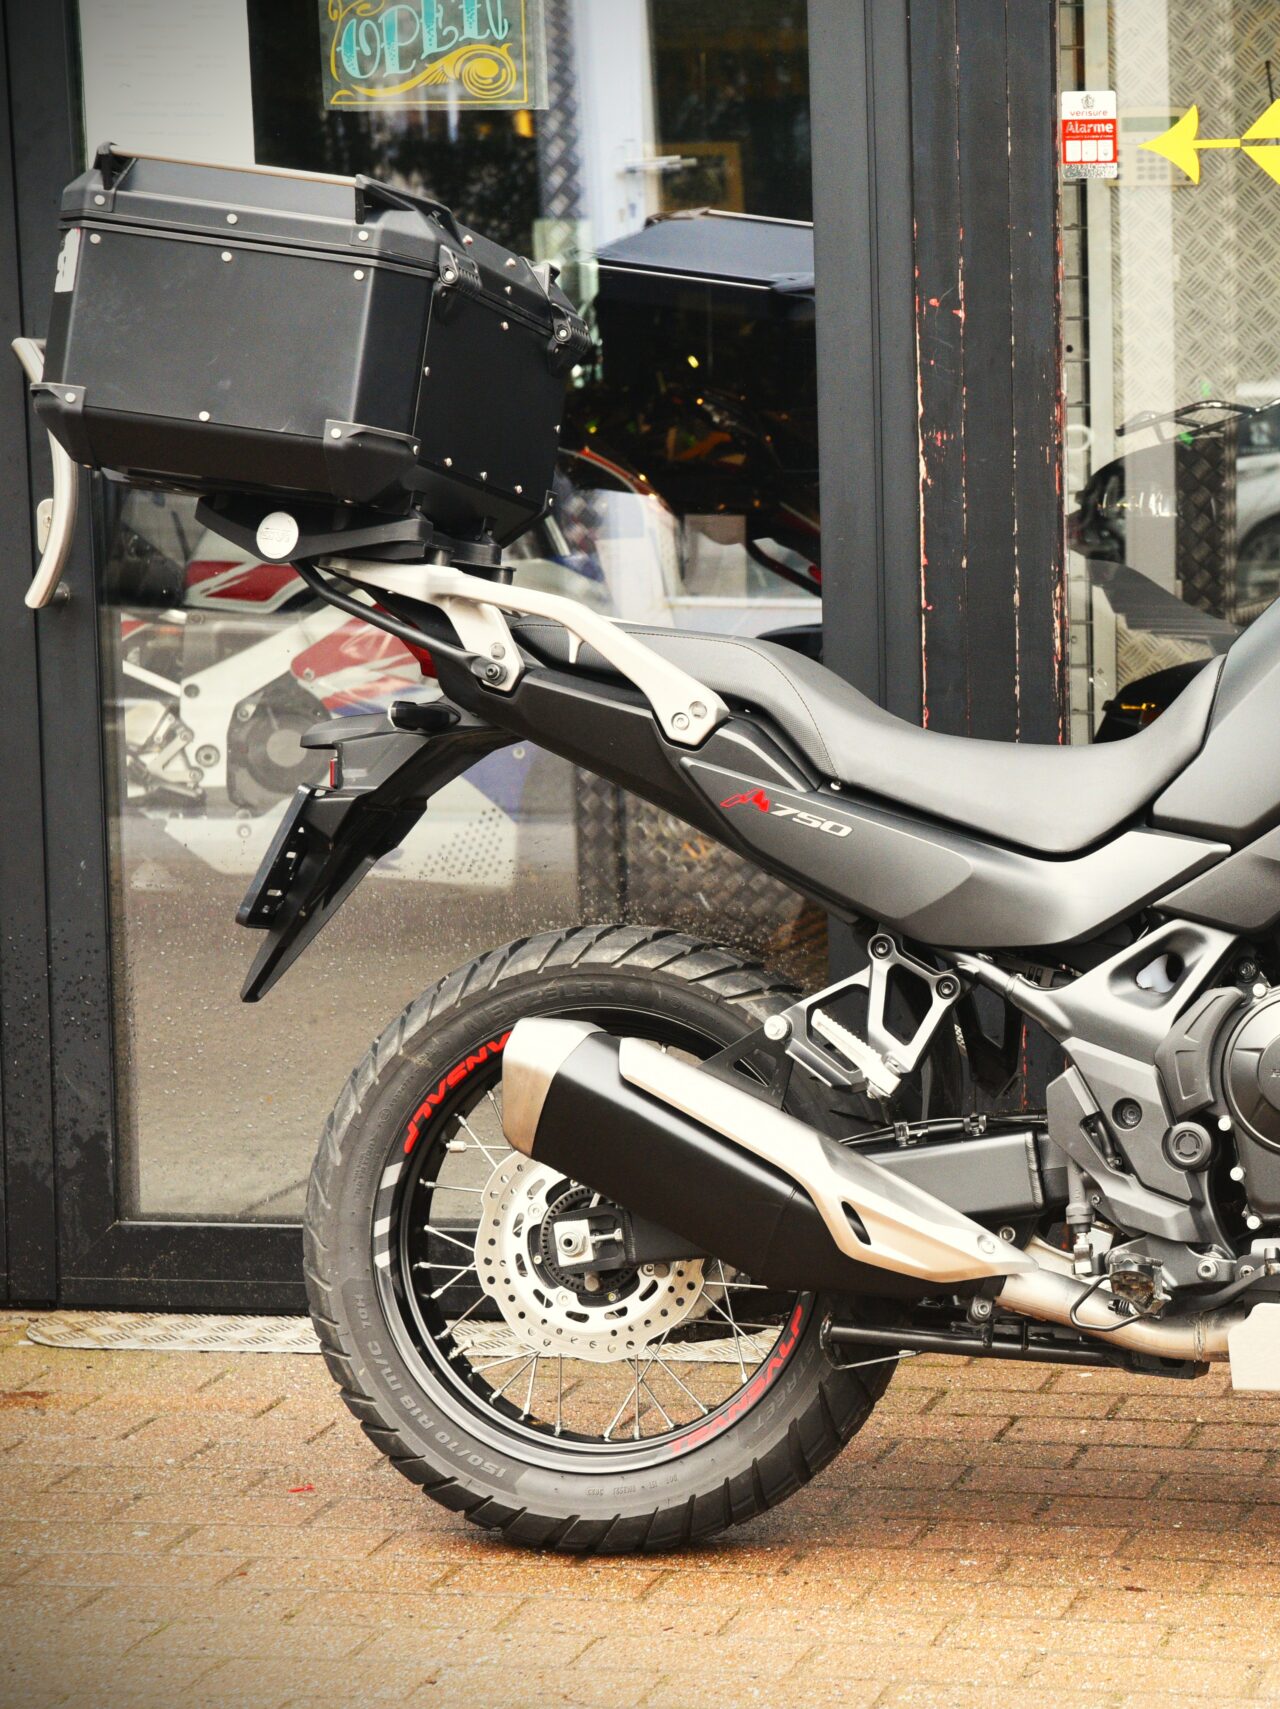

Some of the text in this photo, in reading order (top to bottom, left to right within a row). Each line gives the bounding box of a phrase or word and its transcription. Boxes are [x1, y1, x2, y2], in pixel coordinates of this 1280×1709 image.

[336, 0, 510, 78] OPEN
[1065, 121, 1114, 133] Alarme
[770, 803, 853, 837] 750
